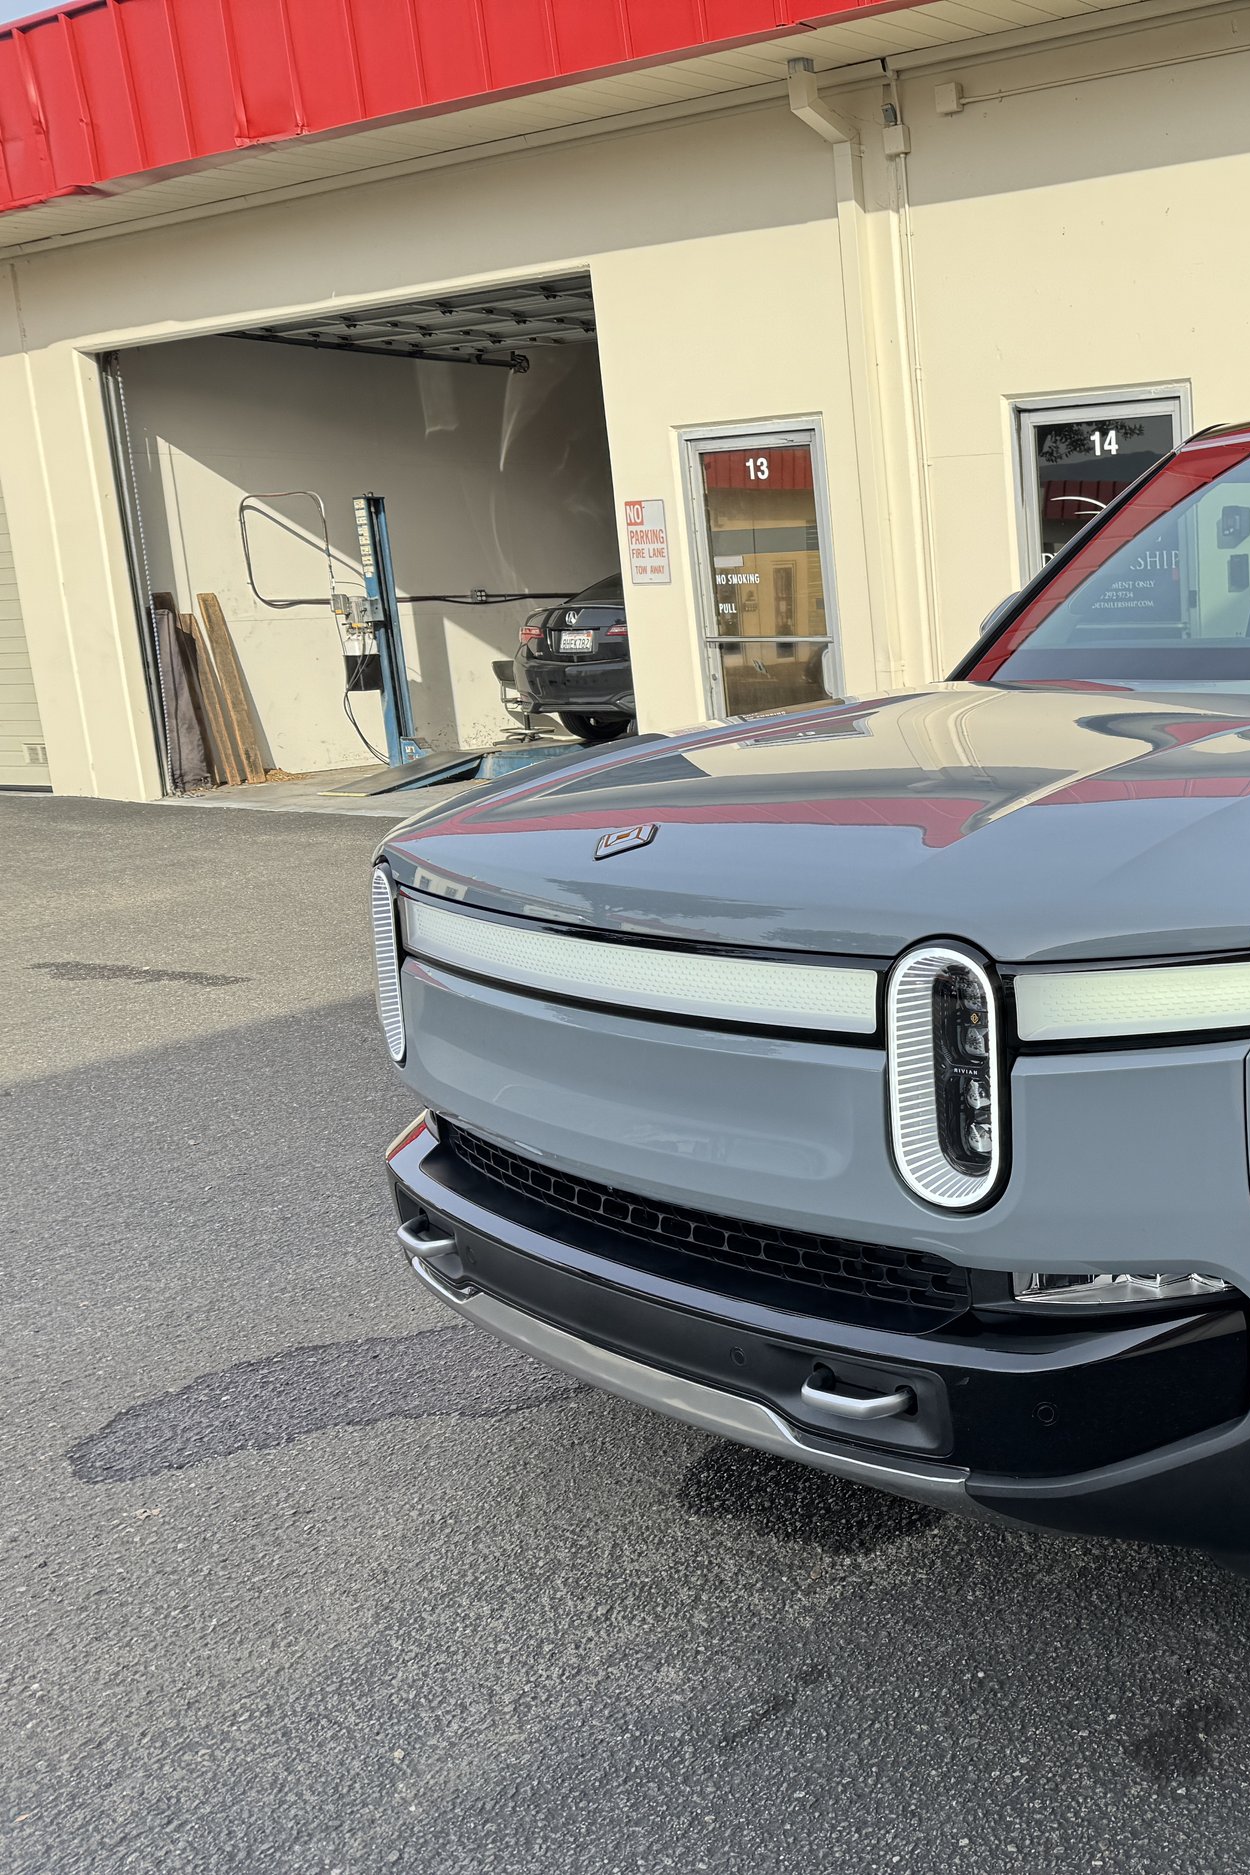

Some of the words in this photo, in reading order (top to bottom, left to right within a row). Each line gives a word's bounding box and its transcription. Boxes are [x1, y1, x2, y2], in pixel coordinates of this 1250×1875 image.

[1090, 430, 1119, 456] 14
[745, 457, 769, 480] 13
[626, 504, 642, 523] NO
[629, 529, 665, 545] PARKING
[631, 548, 646, 559] FIRE
[648, 547, 666, 558] LANE
[635, 565, 648, 575] TOW
[650, 564, 665, 574] AWAY
[716, 574, 726, 584] NO
[727, 573, 760, 584] SMOKING
[1135, 580, 1155, 588] ONLY
[718, 603, 737, 614] PULL
[953, 1067, 978, 1075] RIVIAN
